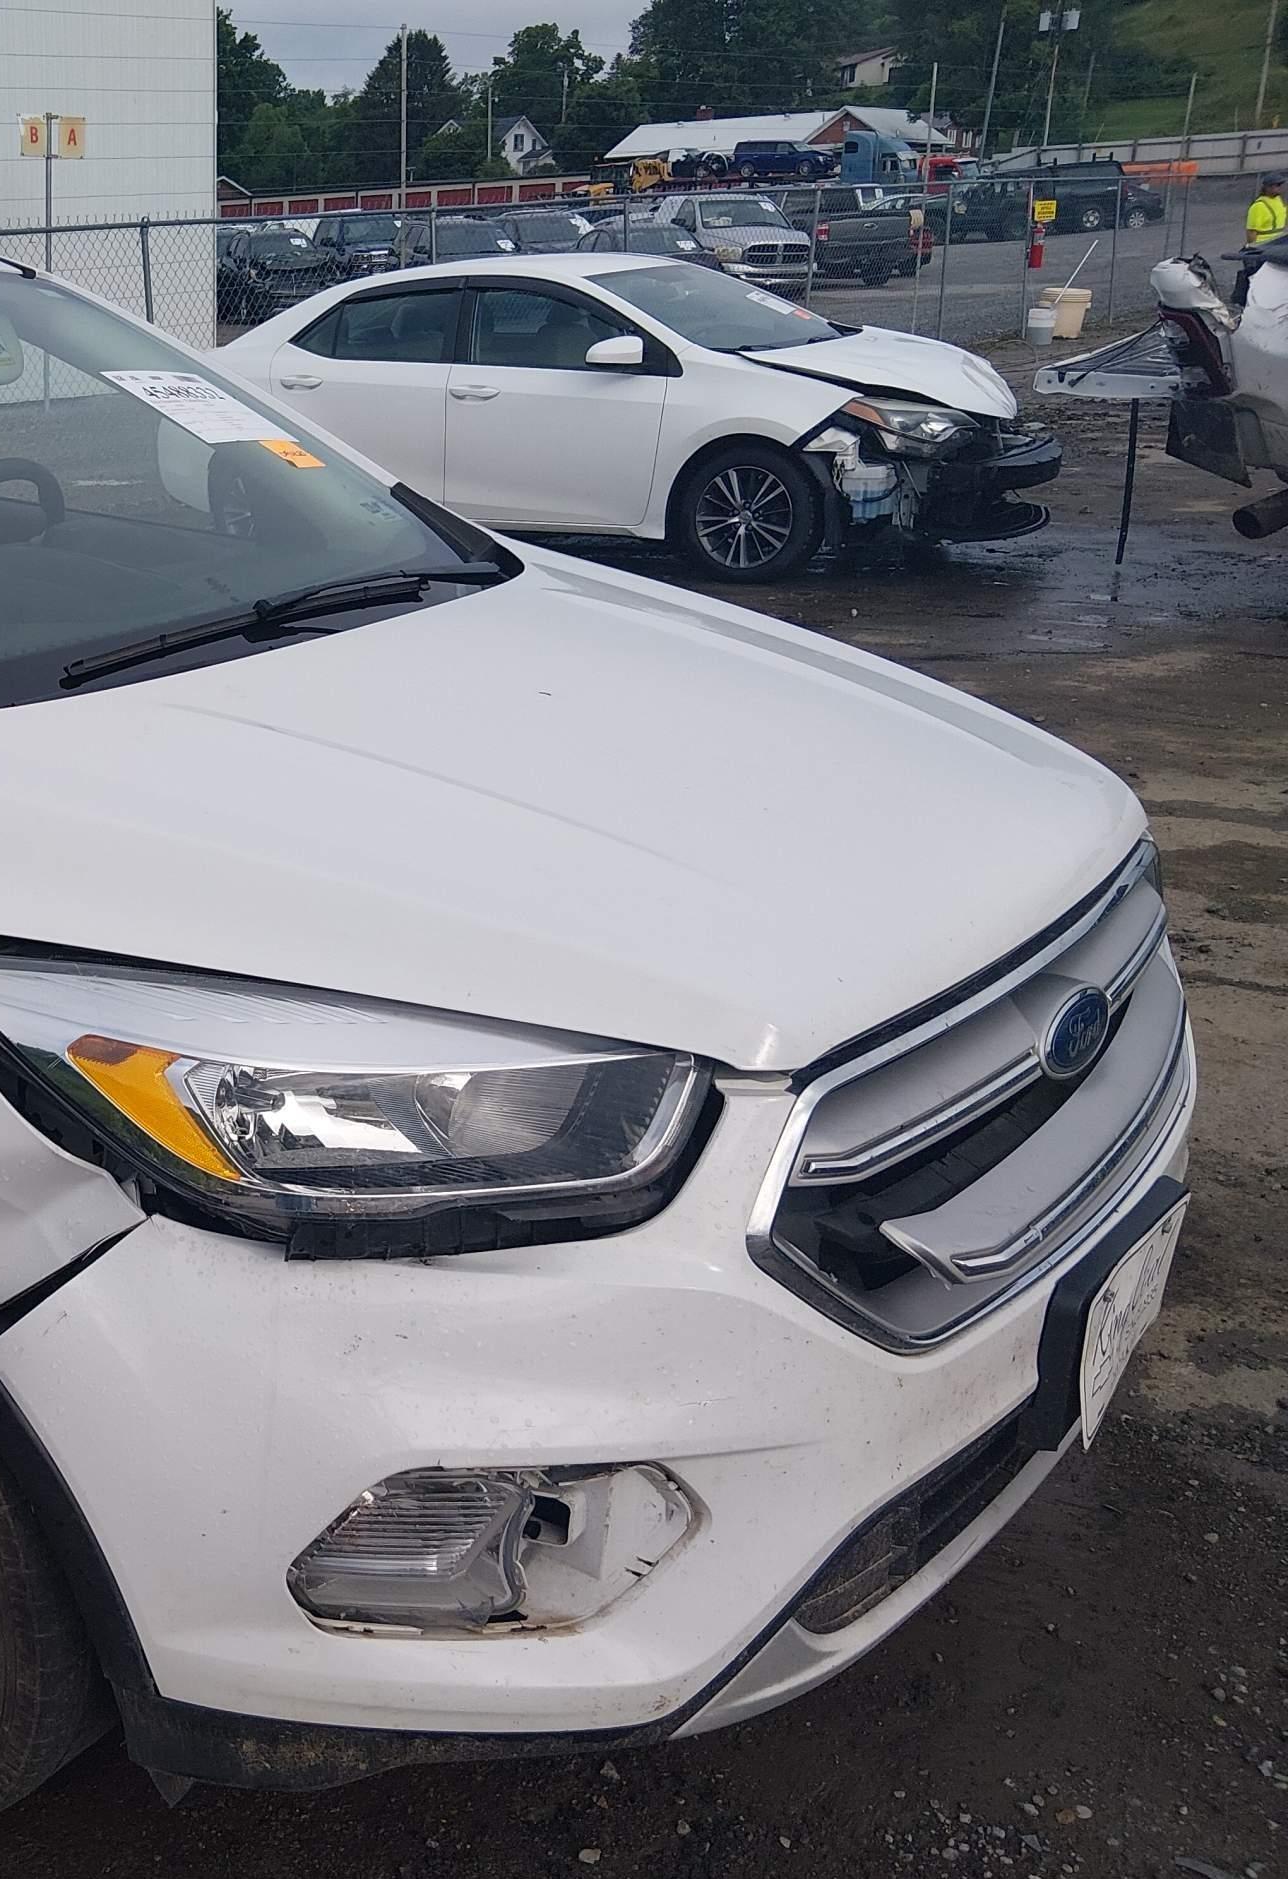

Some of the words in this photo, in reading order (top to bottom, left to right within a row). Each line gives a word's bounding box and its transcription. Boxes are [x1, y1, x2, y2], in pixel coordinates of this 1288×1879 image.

[29, 126, 39, 144] B
[67, 127, 77, 146] A
[1068, 1006, 1102, 1058] Ford
